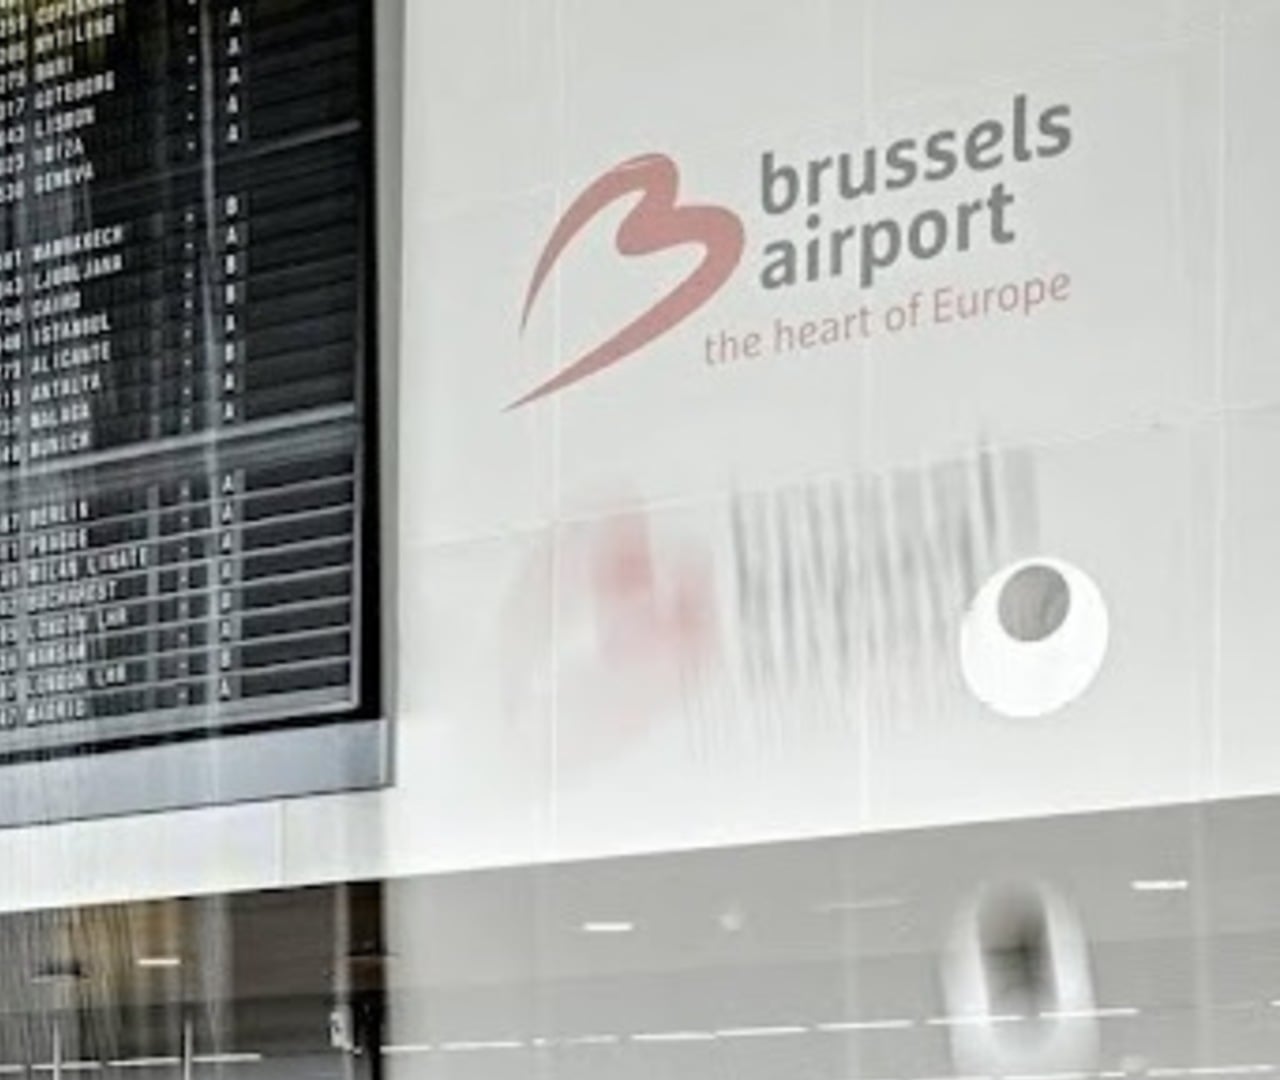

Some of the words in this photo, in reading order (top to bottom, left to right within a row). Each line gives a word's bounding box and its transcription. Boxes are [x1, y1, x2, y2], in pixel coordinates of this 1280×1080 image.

[760, 94, 1072, 216] brussels
[759, 182, 1016, 290] airport
[704, 329, 761, 367] the
[773, 304, 871, 355] heart
[884, 291, 922, 333] of
[933, 272, 1072, 326] Europe
